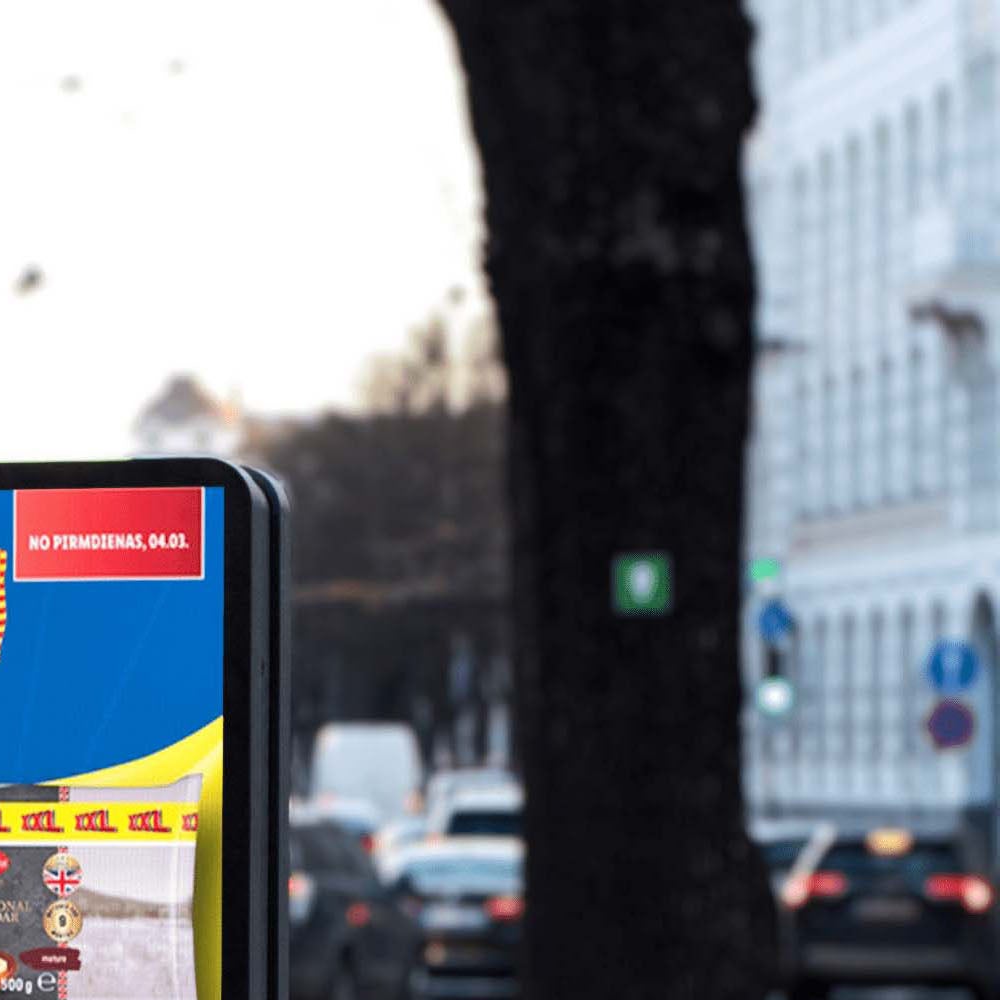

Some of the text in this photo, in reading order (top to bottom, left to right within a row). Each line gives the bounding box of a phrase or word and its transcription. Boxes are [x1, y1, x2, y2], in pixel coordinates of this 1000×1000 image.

[29, 532, 189, 552] NO PIRMDIENAS, 04.03.
[21, 810, 64, 833] XXL
[75, 810, 118, 833] XXL
[128, 810, 172, 833] XXL
